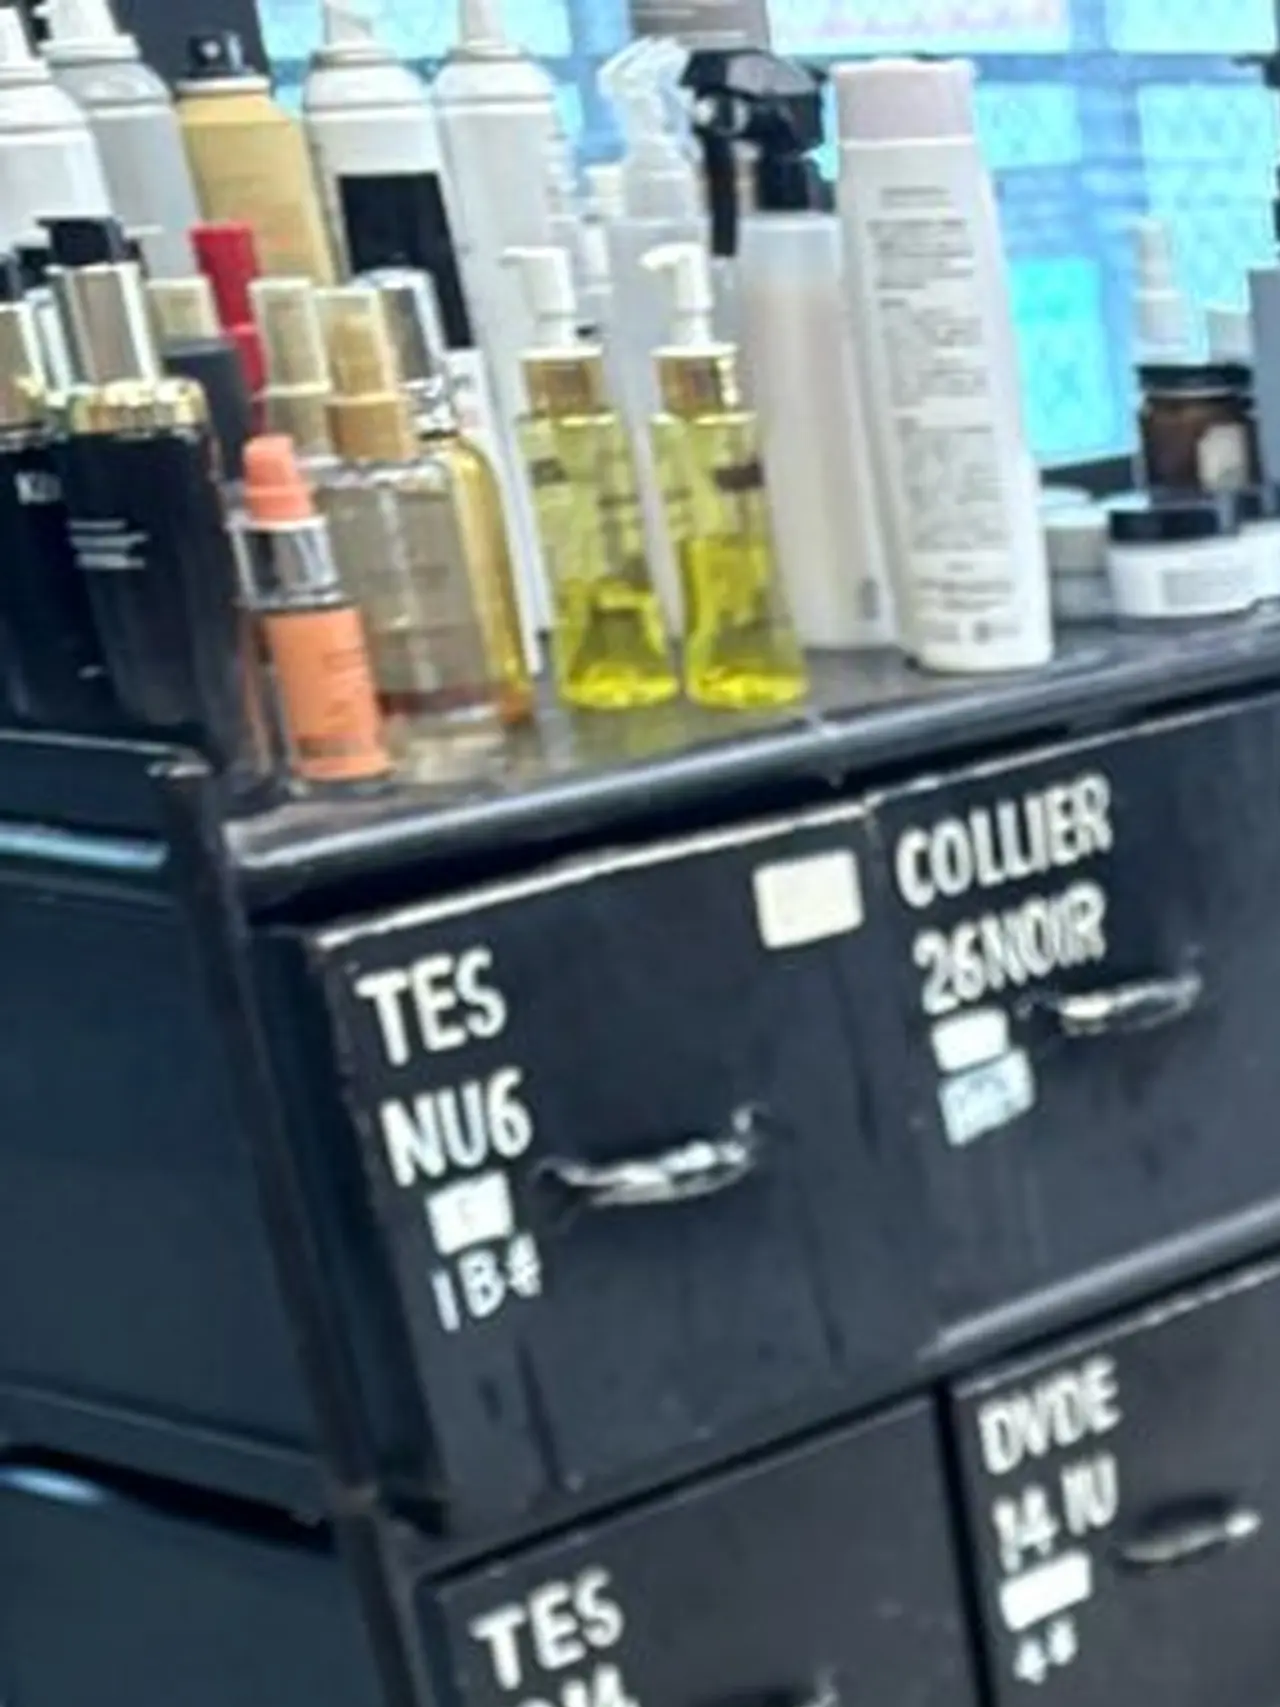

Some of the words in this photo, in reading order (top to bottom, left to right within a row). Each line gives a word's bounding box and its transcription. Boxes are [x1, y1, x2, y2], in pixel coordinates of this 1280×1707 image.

[896, 773, 1113, 907] COLLIER
[354, 945, 507, 1066] TES
[381, 1067, 533, 1187] NU6
[468, 1566, 624, 1690] TES
